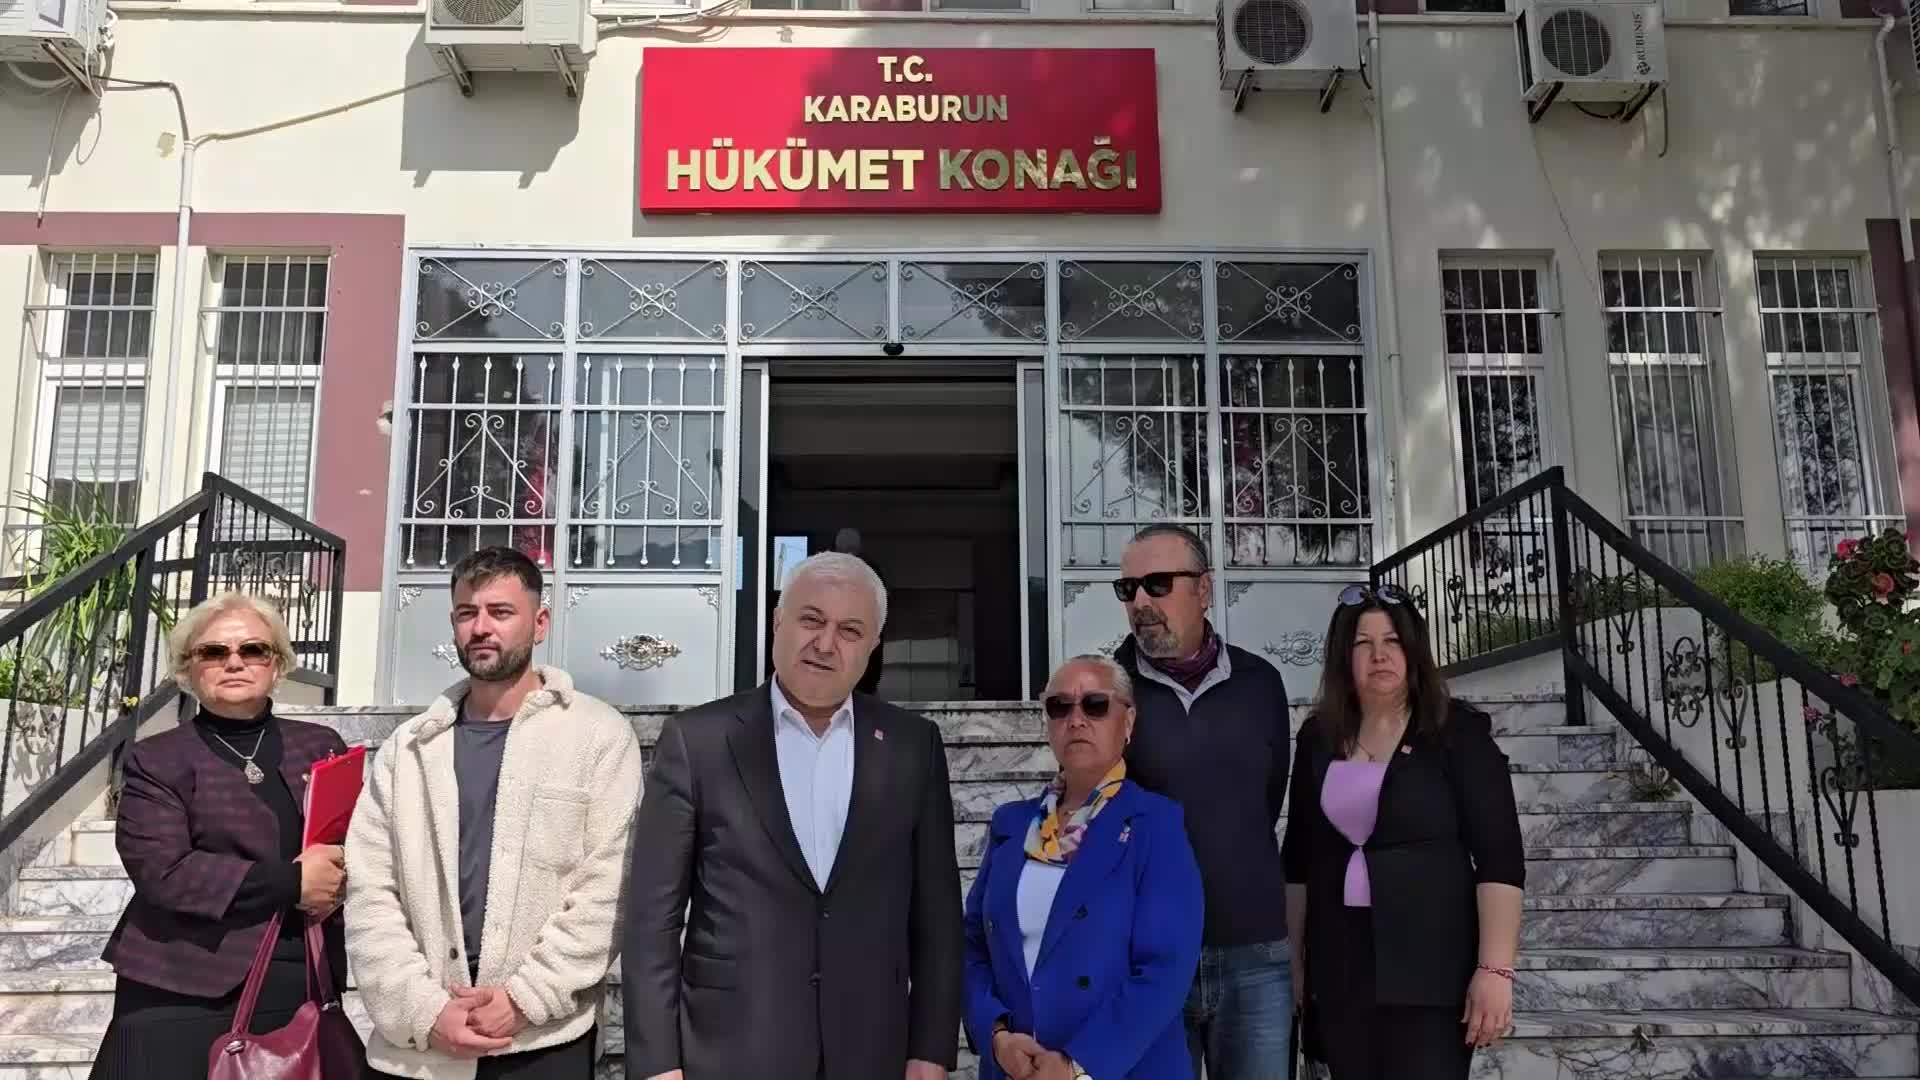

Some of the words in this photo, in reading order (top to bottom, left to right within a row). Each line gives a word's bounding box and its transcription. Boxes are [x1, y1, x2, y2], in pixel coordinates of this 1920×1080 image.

[878, 55, 933, 83] T.C.
[804, 95, 1008, 123] KARABURUN
[667, 137, 924, 191] HÜKÜMET
[939, 136, 1137, 190] KONAĞI
